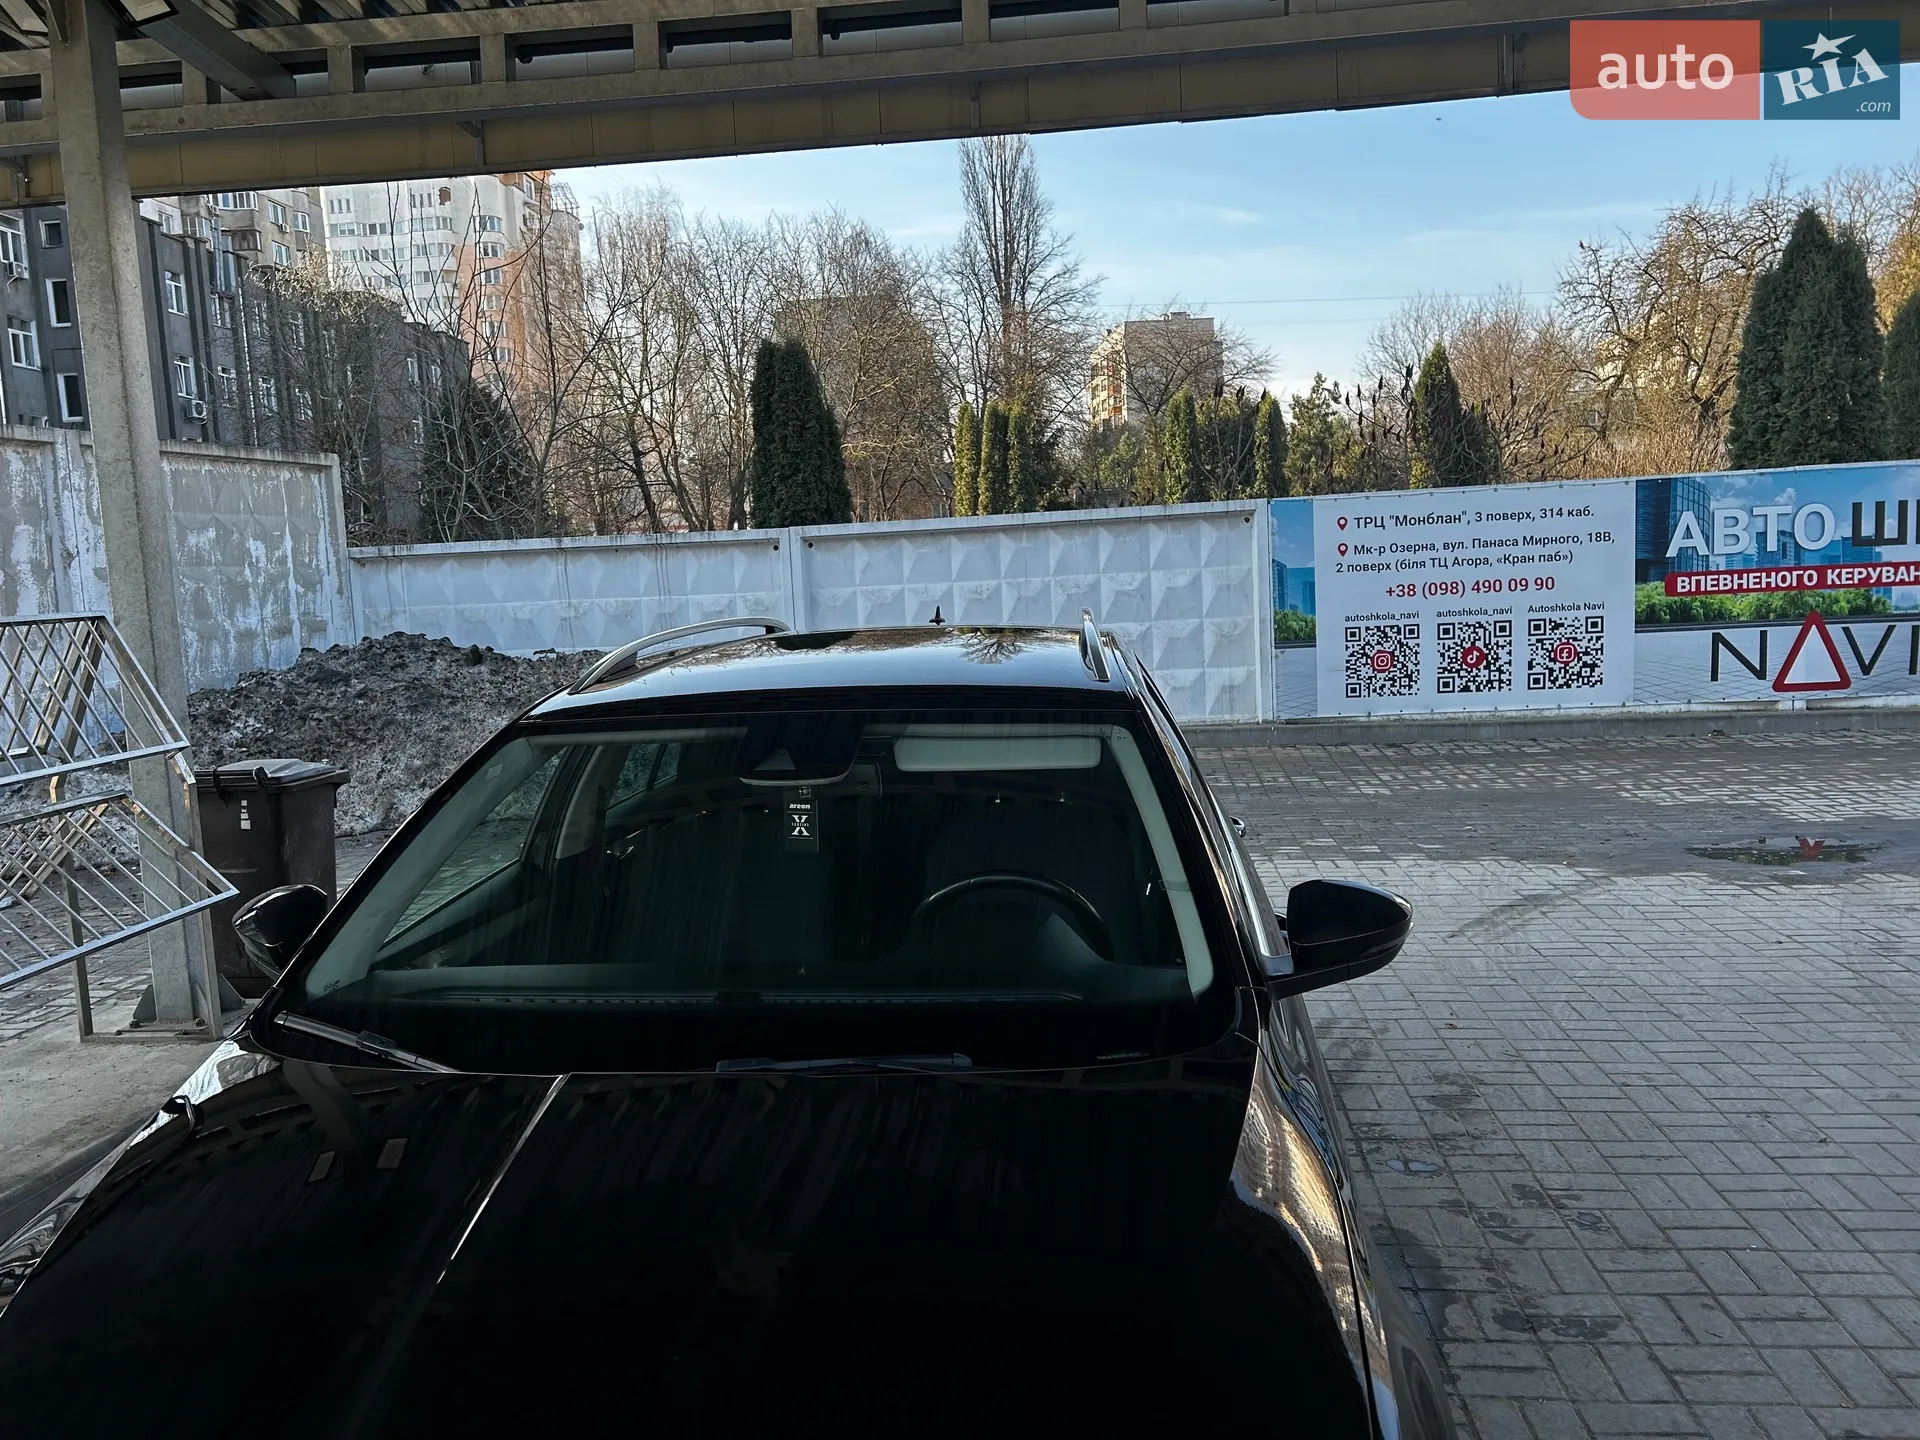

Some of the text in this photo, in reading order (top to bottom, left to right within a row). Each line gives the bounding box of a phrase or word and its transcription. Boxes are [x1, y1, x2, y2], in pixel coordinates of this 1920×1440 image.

[1354, 505, 1594, 530] ТРЦ "Монблан", 3 поверх, 314 каб.
[1665, 499, 1920, 558] АВТО Ш
[1354, 531, 1615, 556] Мк-р Озерна, вул. Панаса Мирного, 18В,
[1336, 549, 1574, 573] 2 поверх (біля ТЦ Агора, «Кран паб»)
[1386, 576, 1556, 600] +38 (098) 490 09 90
[1677, 569, 1818, 593] ВПЕВНЕНОГО
[1344, 610, 1420, 622] autoshkola_navi
[1436, 606, 1513, 617] autoshkola_navi
[1527, 601, 1605, 613] Autoshkola Navi
